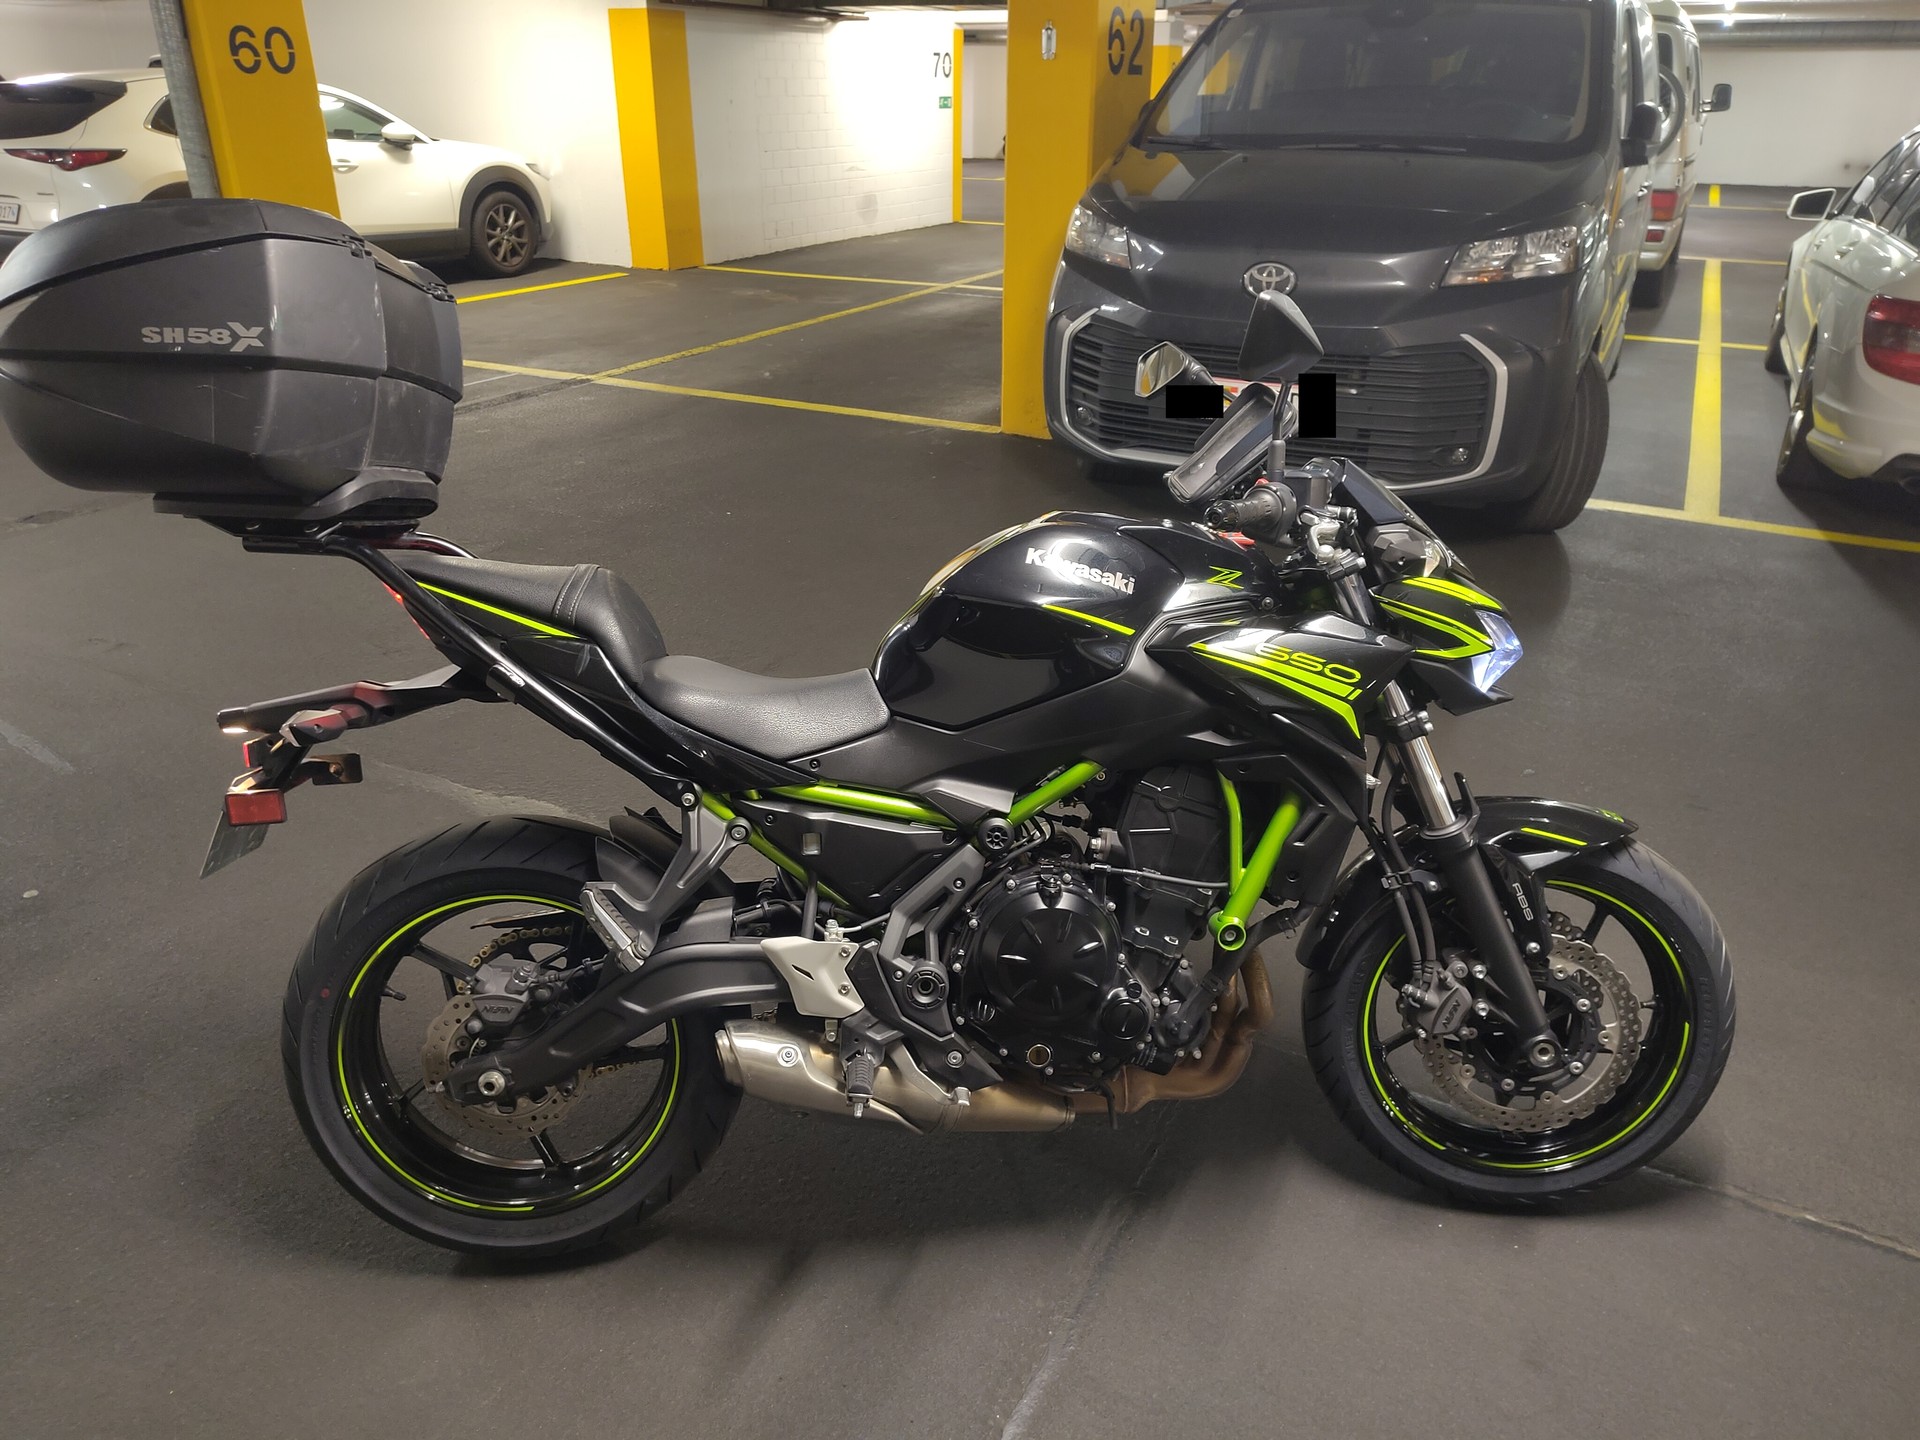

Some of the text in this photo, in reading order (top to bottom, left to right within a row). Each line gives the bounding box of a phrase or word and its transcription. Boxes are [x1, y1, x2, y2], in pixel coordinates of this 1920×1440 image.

[228, 24, 296, 75] 60
[1107, 6, 1145, 76] 62
[933, 52, 952, 78] 70
[141, 321, 265, 353] SH58X
[1024, 547, 1136, 595] Kwasaki
[1254, 642, 1362, 684] 650
[1512, 882, 1534, 921] ABS
